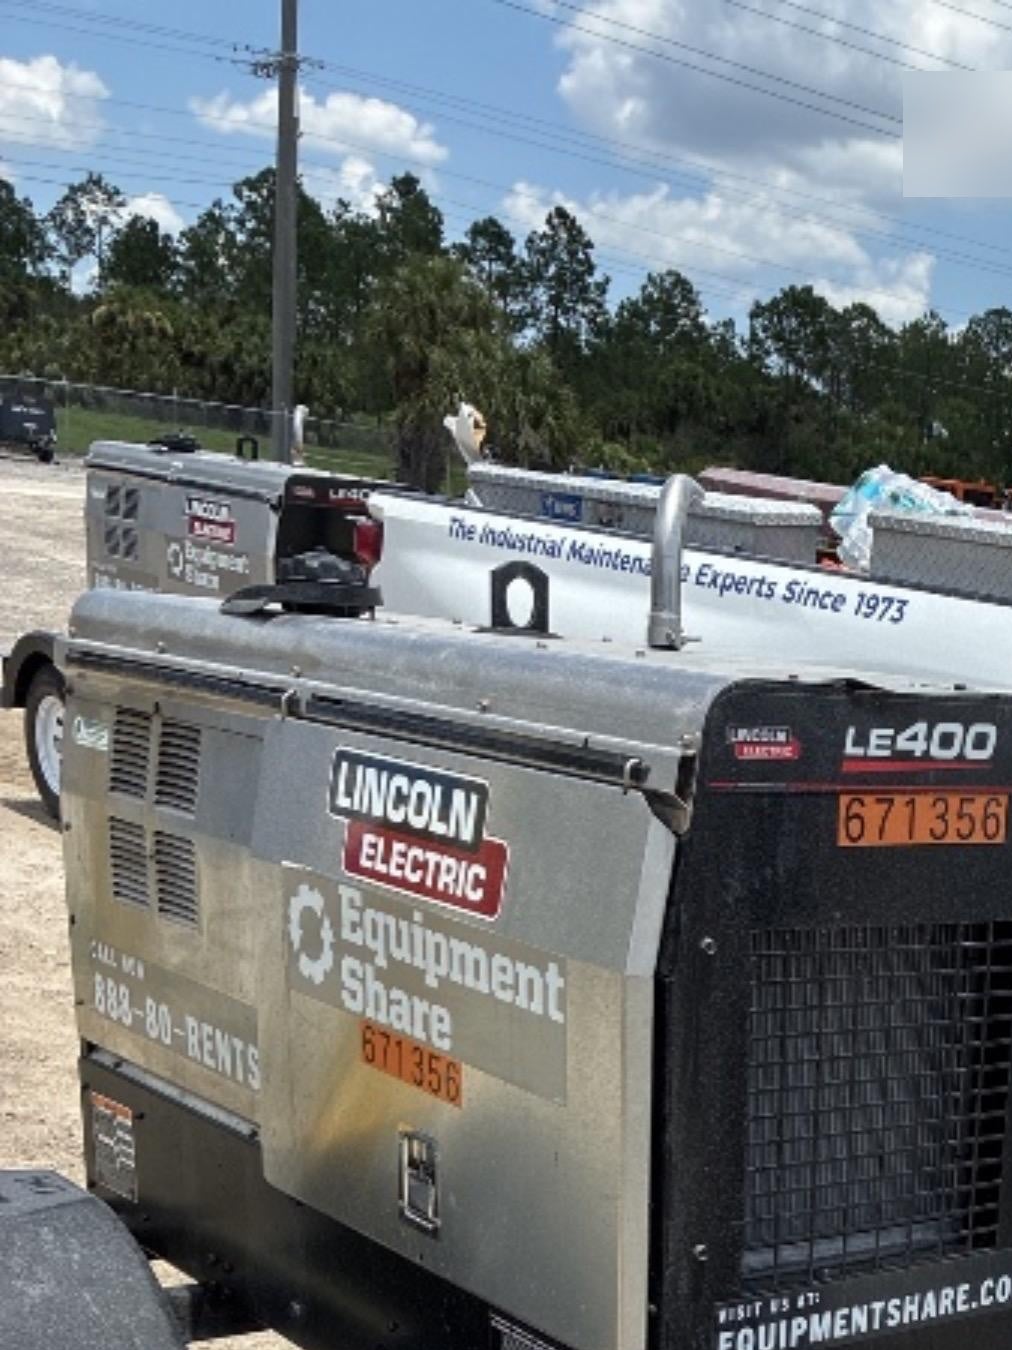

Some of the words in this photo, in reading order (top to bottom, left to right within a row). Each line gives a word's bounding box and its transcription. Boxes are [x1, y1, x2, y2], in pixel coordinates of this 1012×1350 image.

[329, 488, 369, 501] LE40
[448, 515, 477, 543] The
[479, 523, 564, 561] Industrial
[566, 540, 690, 582] Maintenae
[695, 565, 779, 602] Experts
[782, 579, 847, 613] Since
[855, 591, 909, 627] 1973
[844, 722, 997, 760] LE400
[336, 760, 478, 844] LINCOLN
[844, 797, 1002, 843] 671356
[359, 833, 487, 902] ELECTRIC
[338, 884, 564, 1024] Equipment
[340, 954, 451, 1051] Share
[361, 1025, 461, 1106] 671356
[719, 1300, 763, 1324] VISIT
[770, 1297, 790, 1314] US
